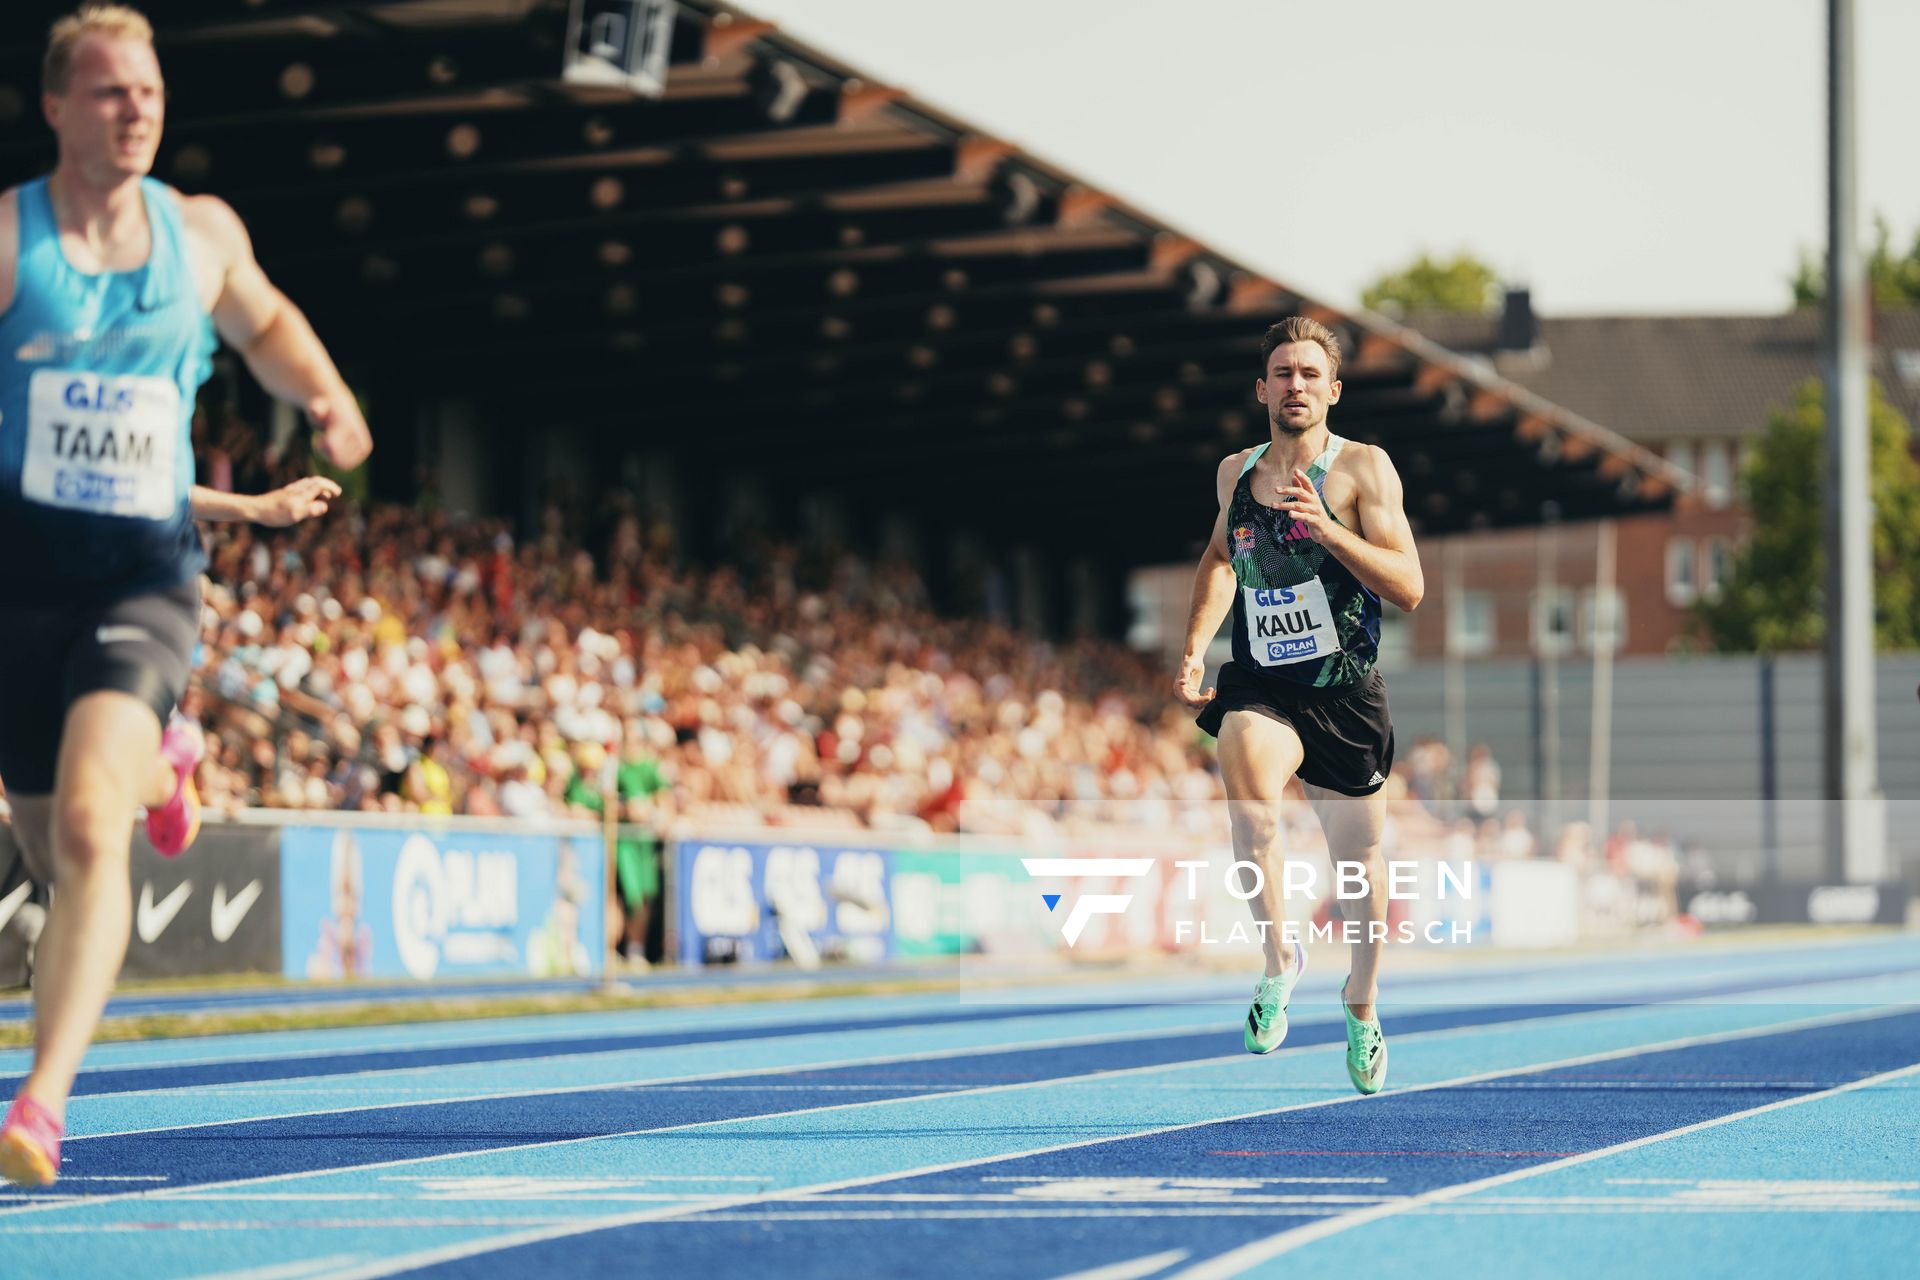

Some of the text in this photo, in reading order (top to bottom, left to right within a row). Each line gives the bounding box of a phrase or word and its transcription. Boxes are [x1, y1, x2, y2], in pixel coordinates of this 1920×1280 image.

[50, 422, 153, 464] TAAM
[1255, 609, 1322, 638] KAUL
[1285, 639, 1314, 652] PLAN
